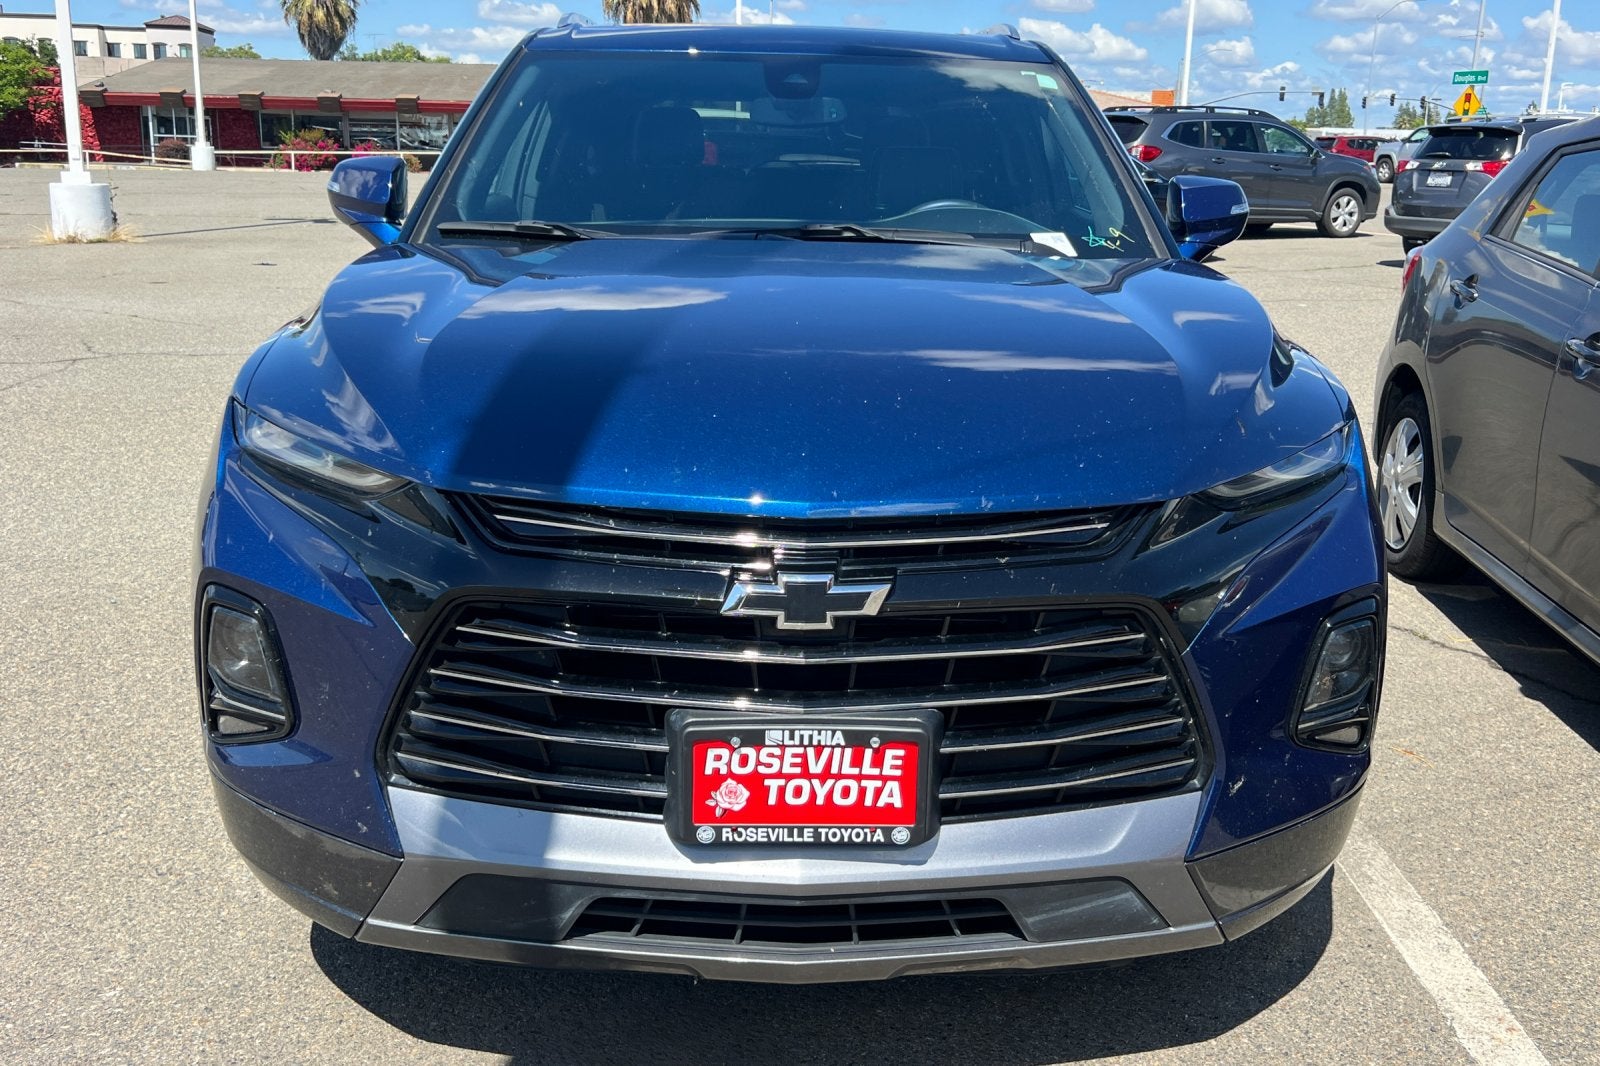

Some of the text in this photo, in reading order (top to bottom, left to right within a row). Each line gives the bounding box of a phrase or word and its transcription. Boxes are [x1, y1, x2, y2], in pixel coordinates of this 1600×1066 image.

[783, 729, 846, 746] LITHIA
[704, 747, 905, 776] ROSEVILLE
[763, 778, 902, 808] TOYOTA
[721, 827, 885, 843] ROSEVILLE TOYOTA
